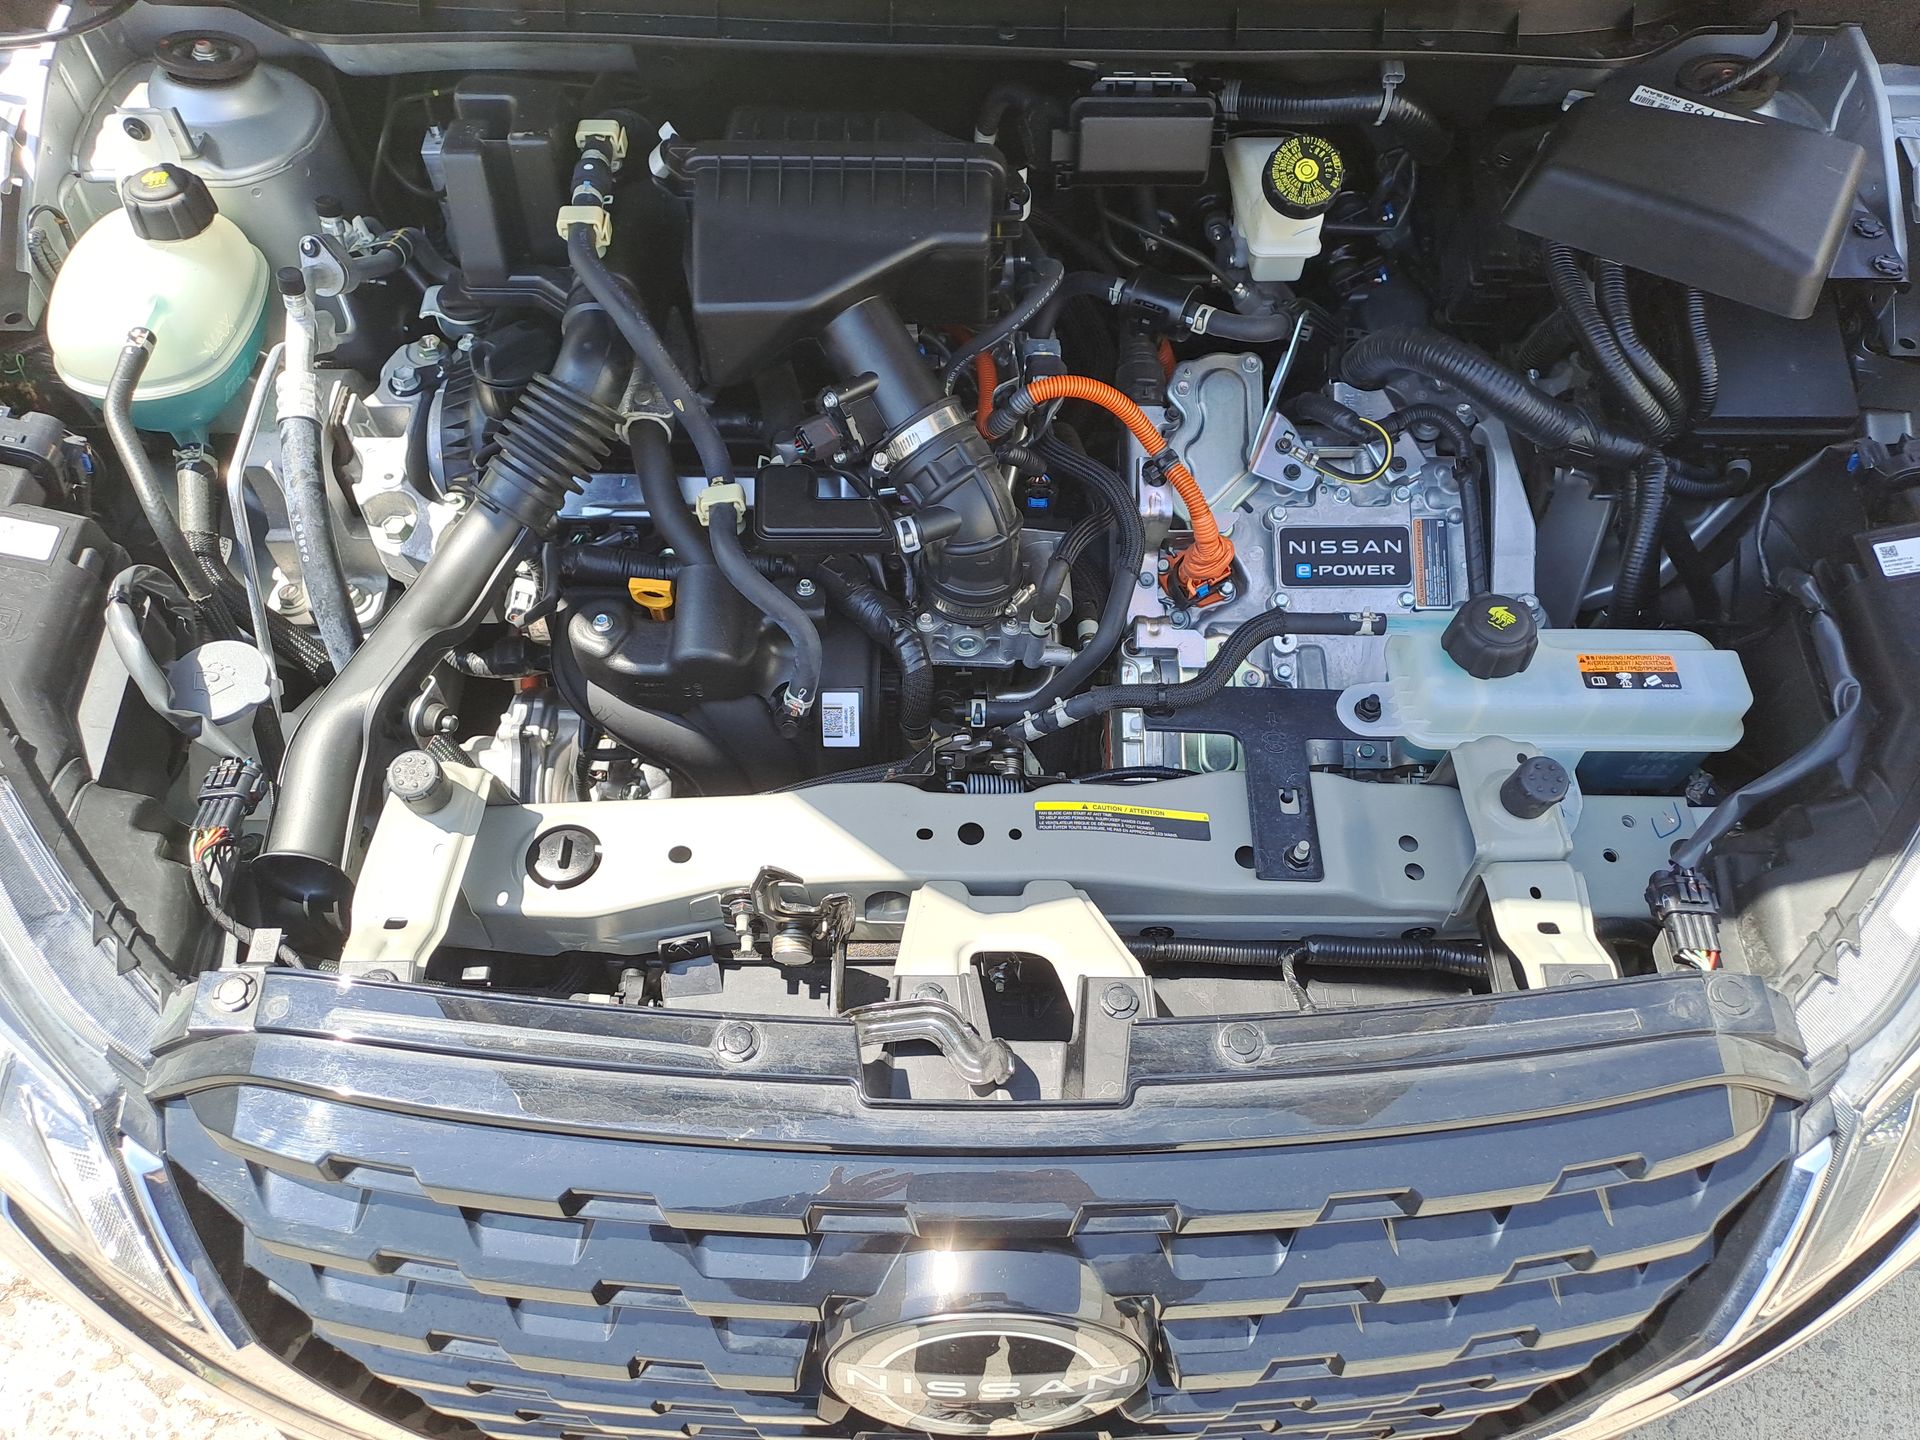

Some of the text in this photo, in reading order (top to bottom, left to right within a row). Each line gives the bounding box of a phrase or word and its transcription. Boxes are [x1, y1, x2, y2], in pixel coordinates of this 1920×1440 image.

[1641, 88, 1681, 104] NISSAN
[1288, 540, 1402, 554] NISSAN
[1297, 564, 1395, 577] e-POWER
[1129, 808, 1165, 816] ATTENTION
[846, 1368, 1129, 1399] NISSAN
